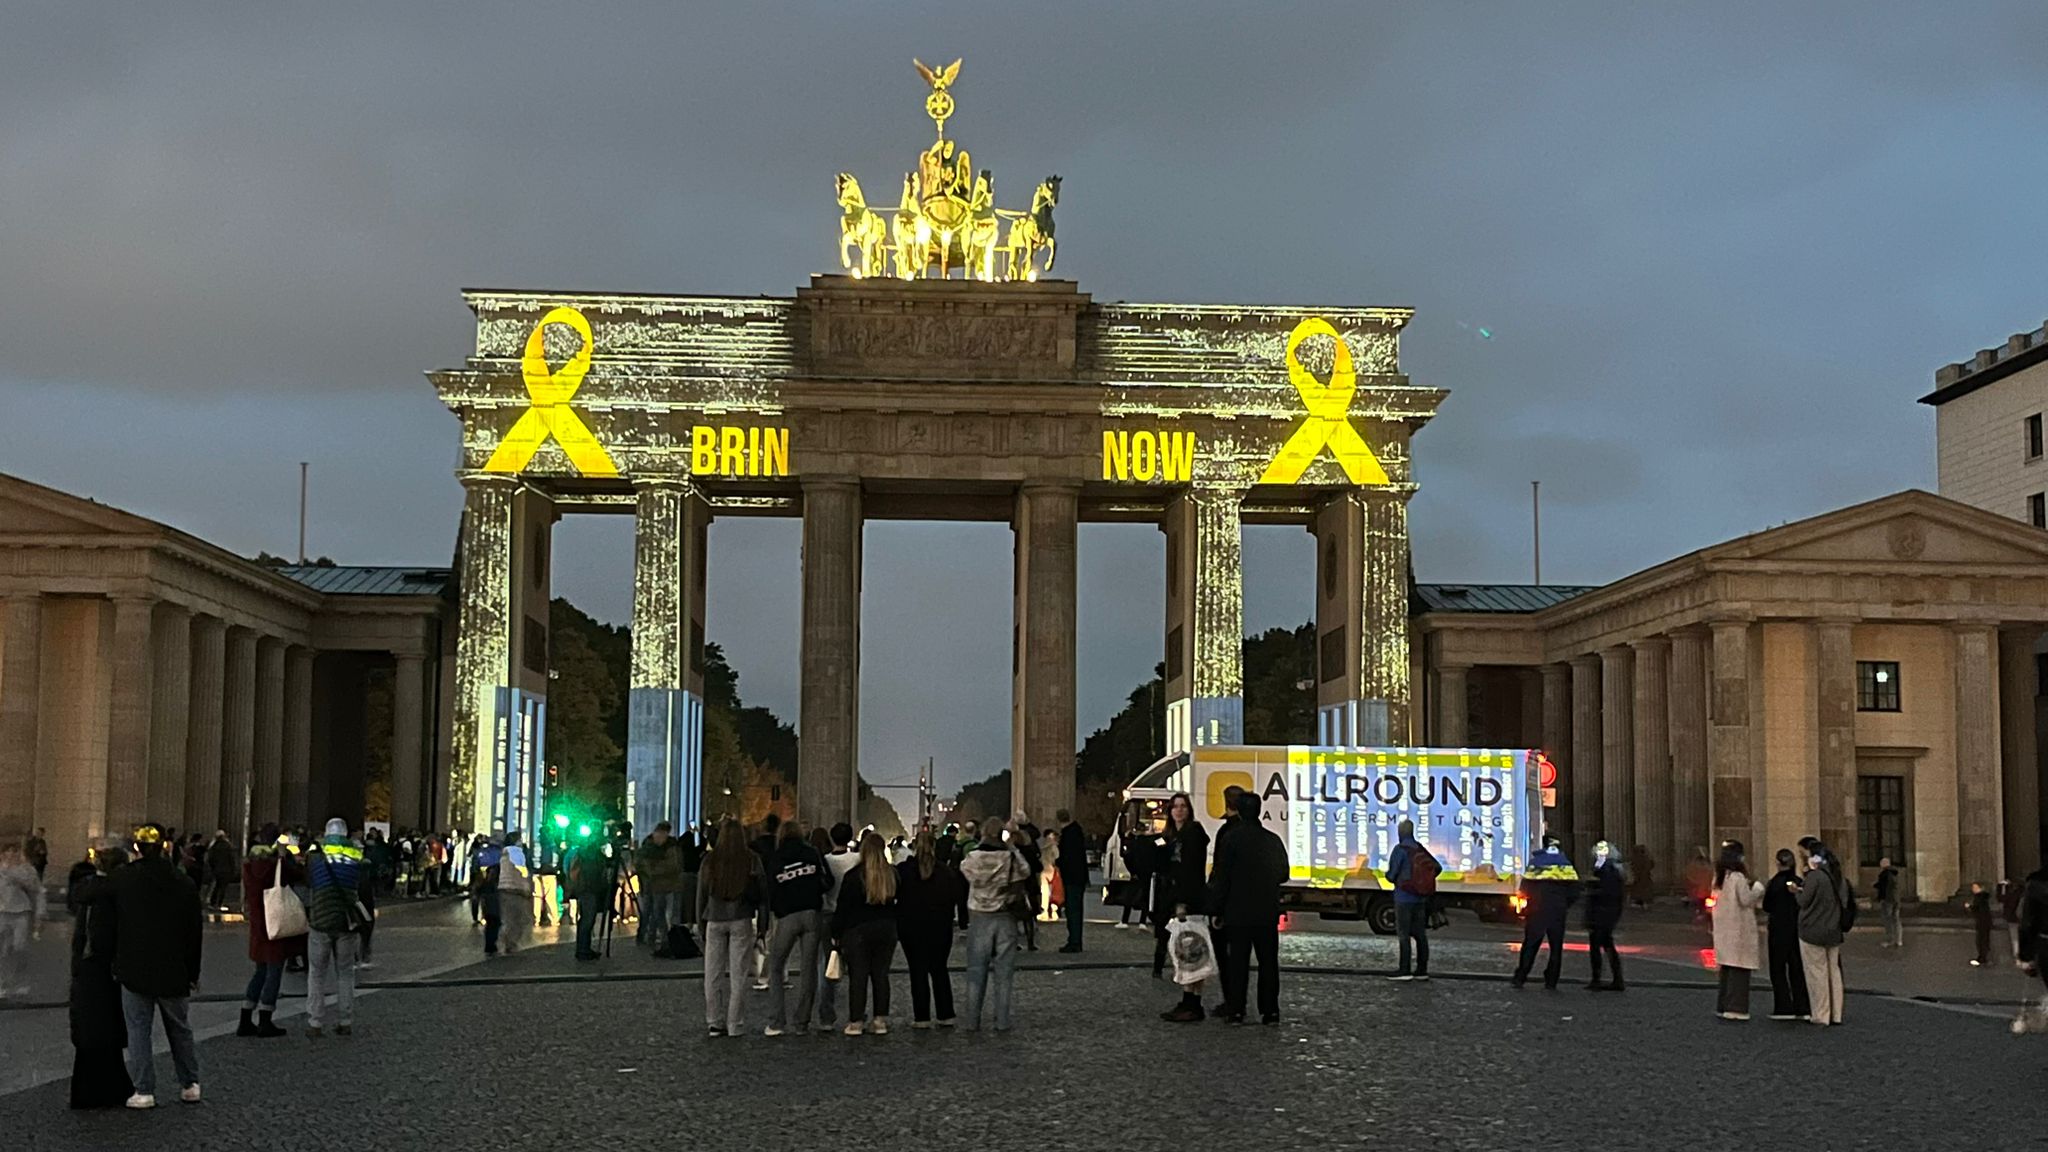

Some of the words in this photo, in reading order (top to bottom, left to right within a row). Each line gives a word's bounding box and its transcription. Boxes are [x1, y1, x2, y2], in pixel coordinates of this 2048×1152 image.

[692, 426, 789, 476] BRIN
[1103, 430, 1195, 481] NOW
[1262, 772, 1502, 806] ALLROUND
